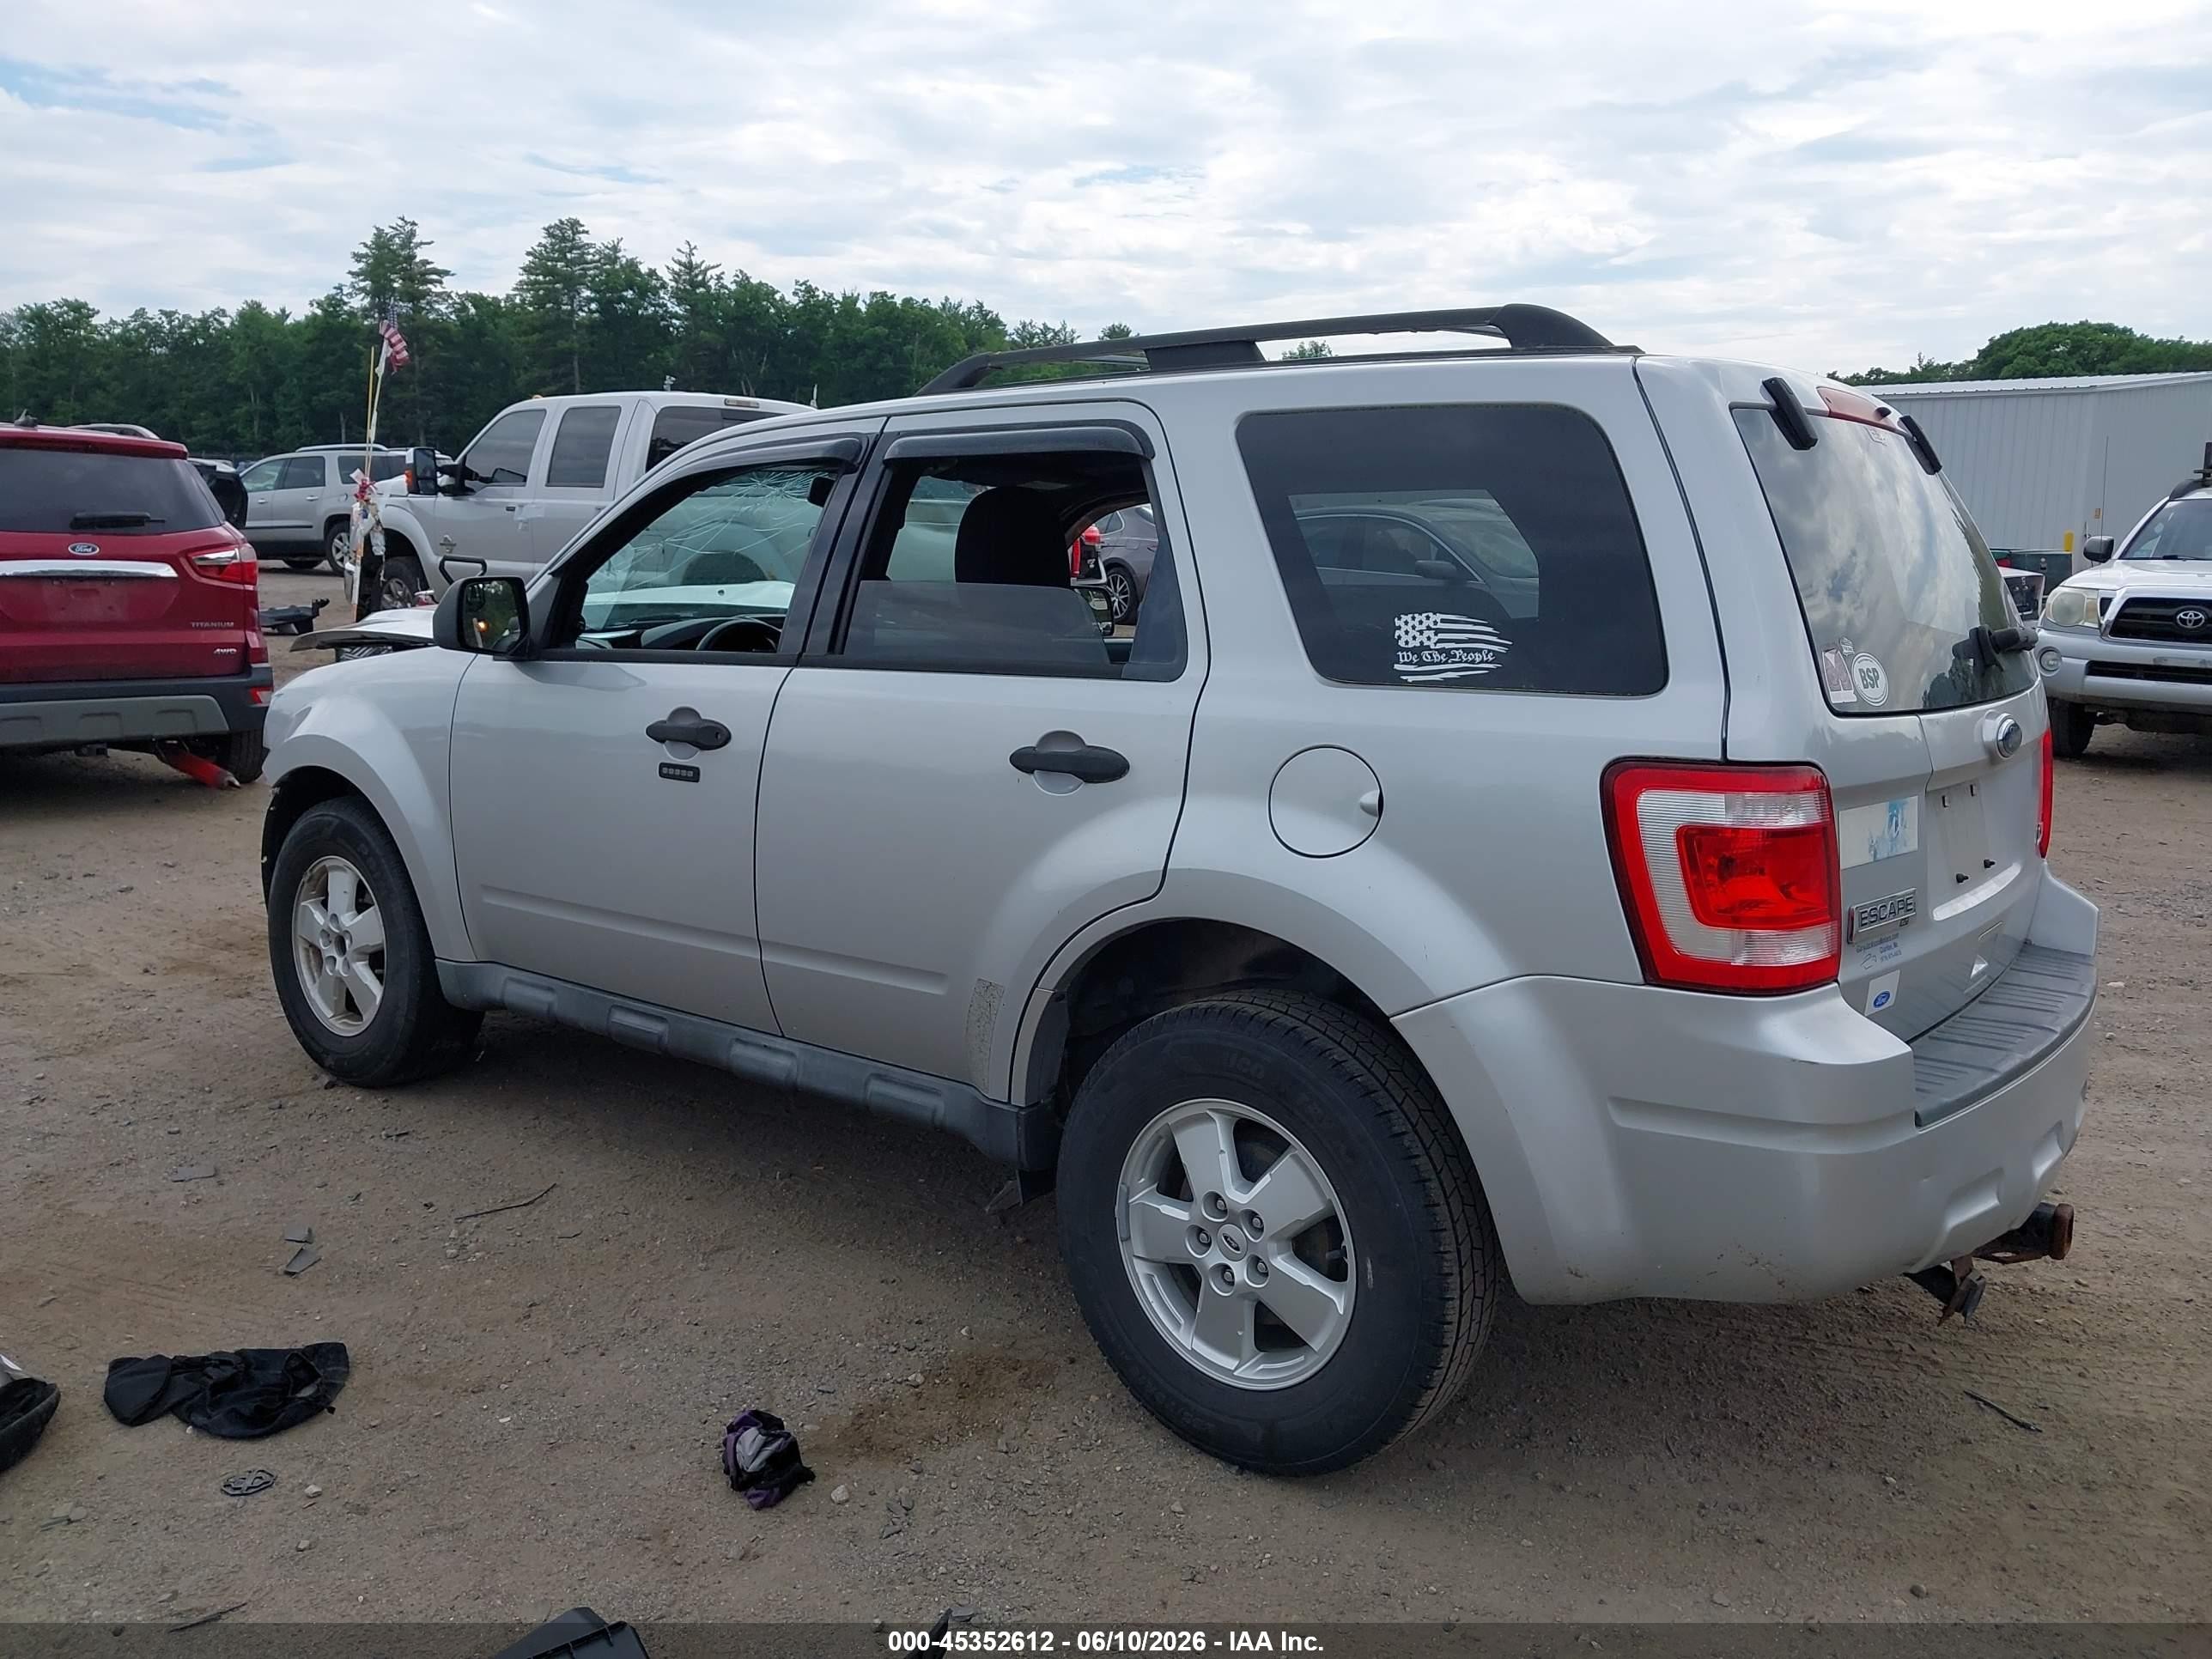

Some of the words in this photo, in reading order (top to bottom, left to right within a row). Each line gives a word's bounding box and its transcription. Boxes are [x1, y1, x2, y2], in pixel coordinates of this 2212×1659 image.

[1396, 651, 1419, 664] We
[1421, 650, 1448, 664] The
[1448, 649, 1496, 664] People
[1858, 667, 1880, 690] BSP
[1859, 894, 1915, 927] ESCAPE
